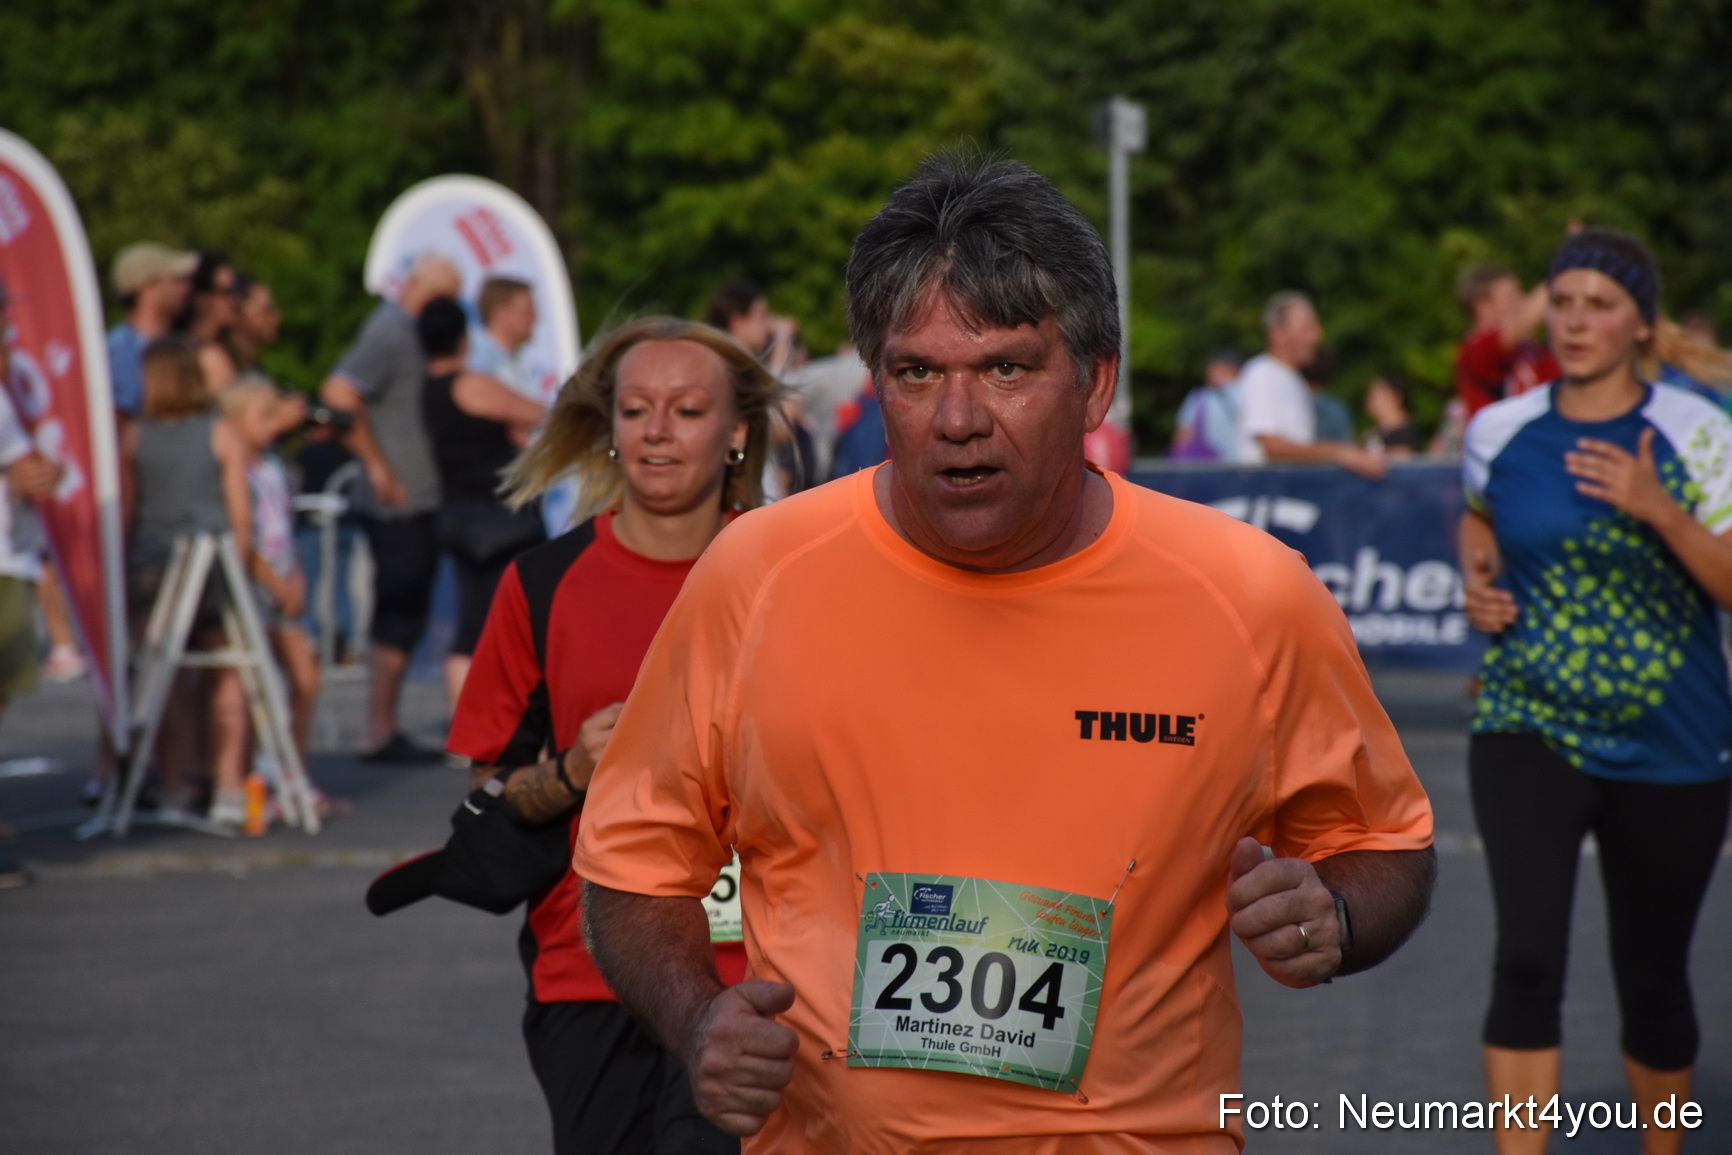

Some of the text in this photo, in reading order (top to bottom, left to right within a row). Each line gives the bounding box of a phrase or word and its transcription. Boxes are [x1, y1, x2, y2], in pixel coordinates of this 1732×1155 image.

[1075, 710, 1196, 746] THULE
[918, 892, 947, 901] Fischer
[890, 928, 931, 938] neumarkt
[891, 909, 990, 935] firmenlauf
[1007, 936, 1091, 965] run 2019
[874, 942, 1066, 1031] 2304
[895, 1015, 1036, 1048] Martinez David
[921, 1037, 1003, 1058] Thule GmbH
